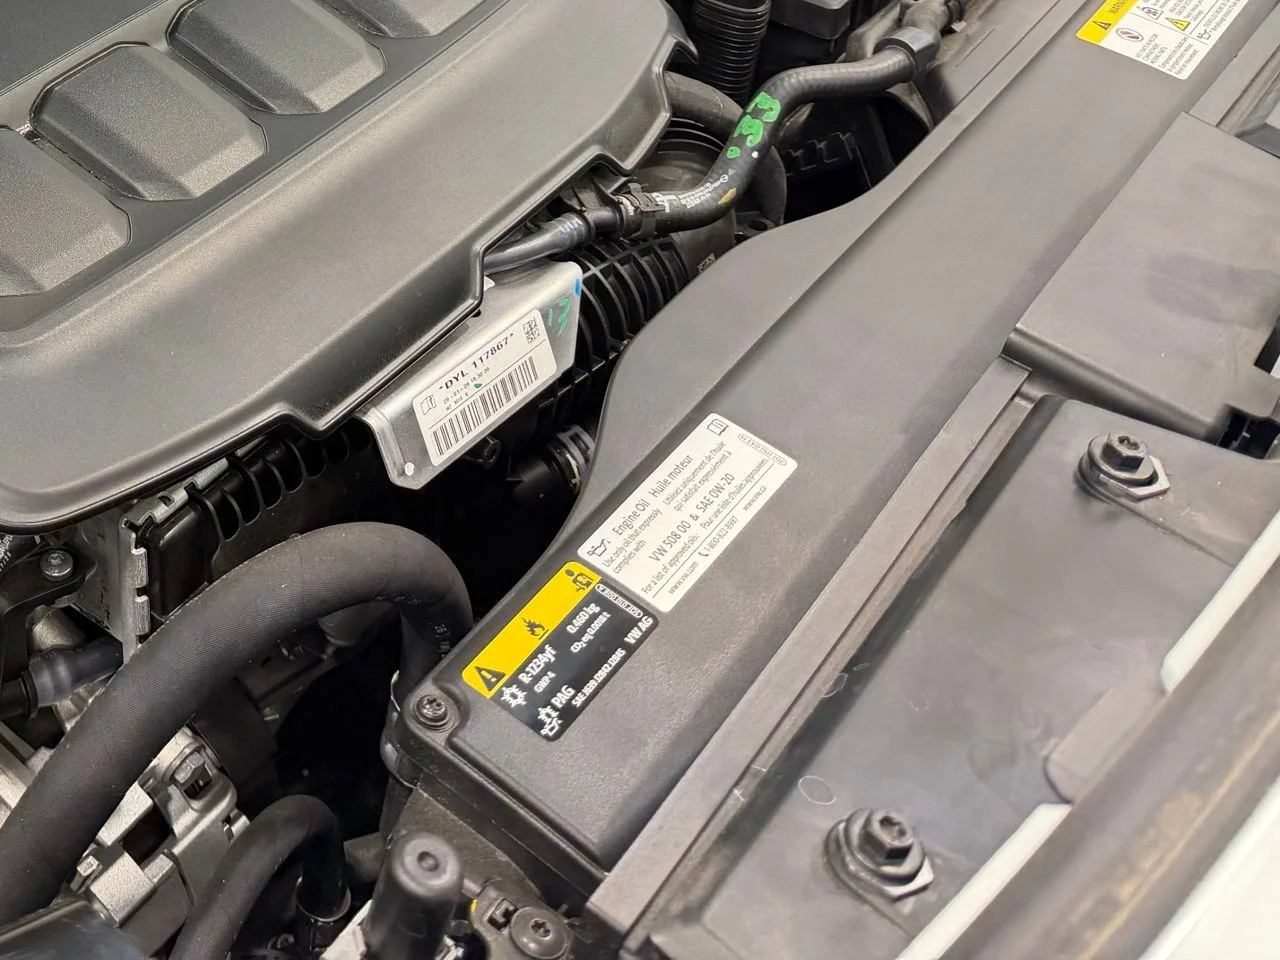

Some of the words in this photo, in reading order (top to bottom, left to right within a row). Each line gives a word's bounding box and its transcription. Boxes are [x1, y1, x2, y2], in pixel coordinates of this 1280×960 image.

[648, 476, 671, 497] Huile
[665, 453, 694, 480] moteur
[703, 453, 714, 461] de
[602, 555, 616, 567] Use
[611, 545, 628, 559] only
[621, 538, 632, 547] oil
[628, 528, 641, 541] that
[637, 507, 663, 532] expressly
[611, 508, 643, 537] Engine
[633, 498, 651, 512] Oil
[649, 544, 669, 562] VW
[662, 531, 681, 548] 508
[675, 519, 691, 533] 00
[687, 511, 699, 521] &
[694, 495, 714, 512] SAE
[708, 472, 735, 498] 0W-20
[611, 550, 638, 575] complies
[632, 538, 647, 552] with
[641, 582, 654, 594] For
[652, 570, 664, 581] list
[659, 564, 670, 573] of
[665, 542, 693, 569] approved
[517, 643, 560, 686] R-1234yf
[565, 610, 590, 634] 0.460
[582, 600, 601, 616] kg
[623, 625, 644, 645] VW
[636, 614, 654, 630] AG
[550, 684, 576, 708] PAG
